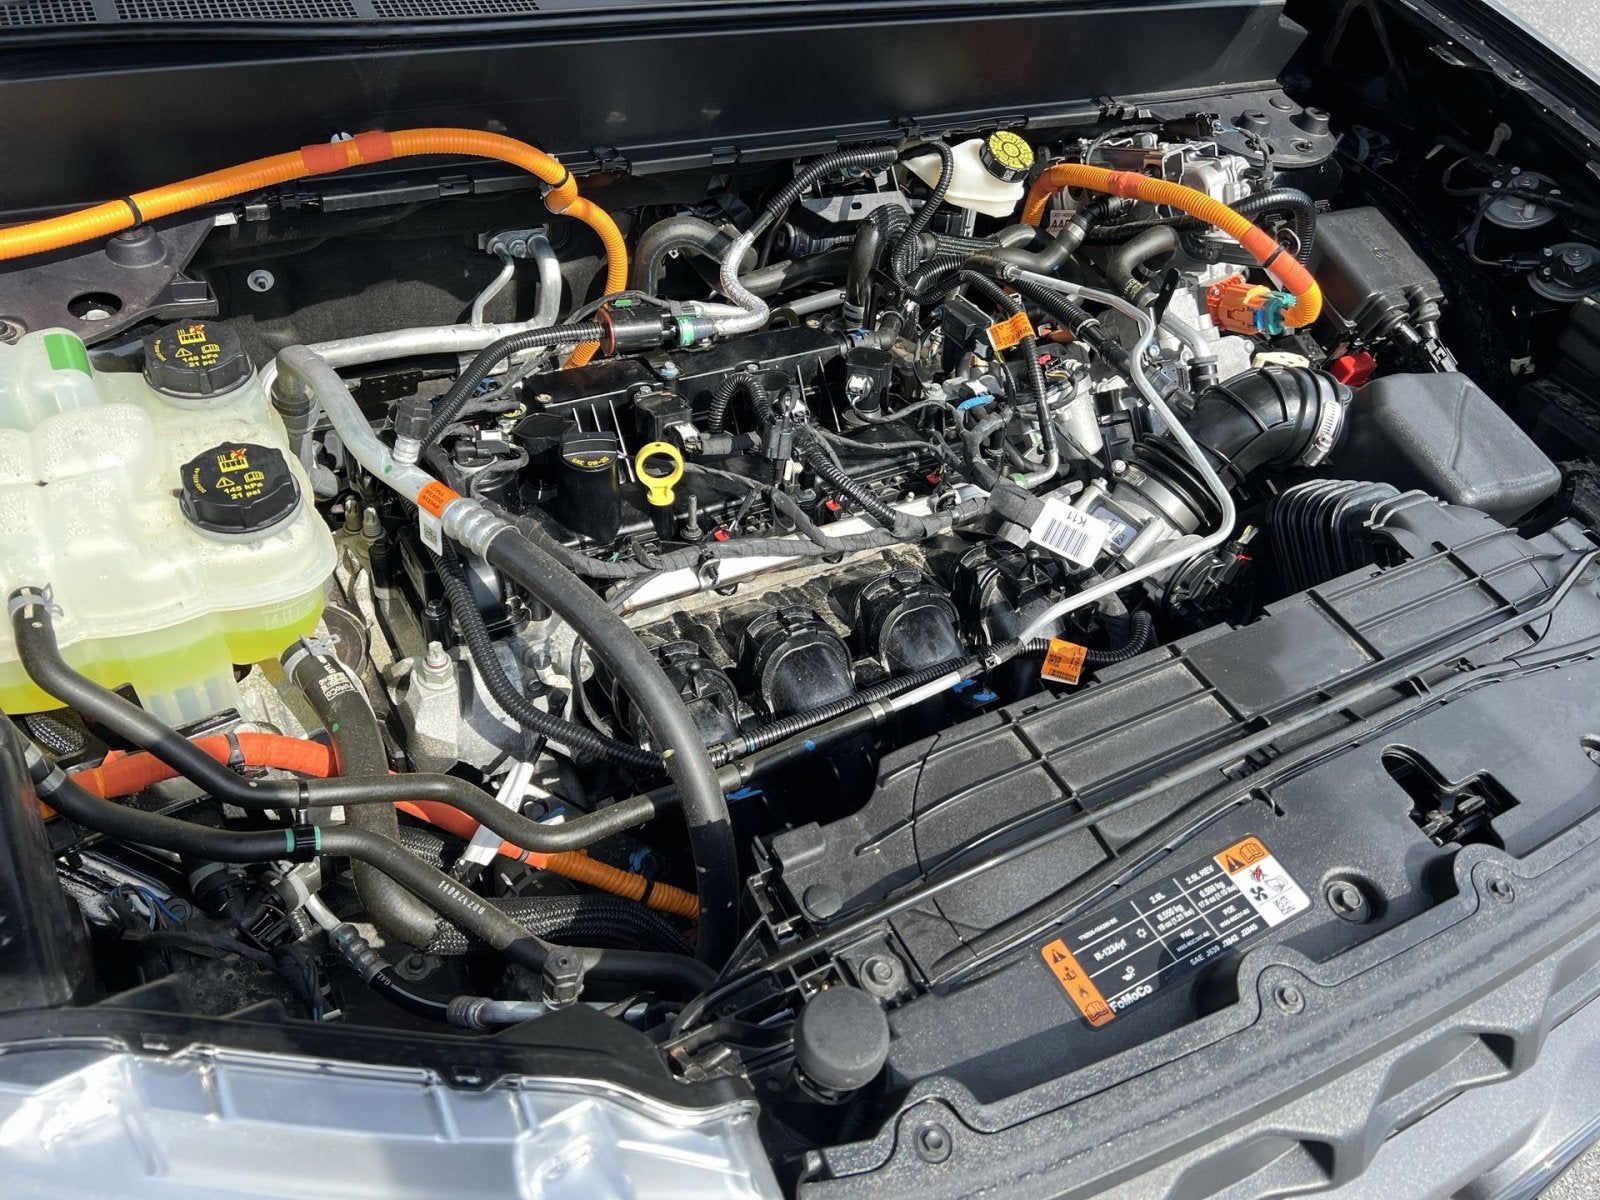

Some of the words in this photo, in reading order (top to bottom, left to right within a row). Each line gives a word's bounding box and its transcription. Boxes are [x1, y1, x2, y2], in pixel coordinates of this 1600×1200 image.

[202, 358, 216, 366] psi
[571, 457, 585, 466] SAE
[223, 485, 242, 494] 145
[244, 482, 263, 490] kPa
[231, 492, 243, 500] 21
[246, 488, 261, 498] psi
[1066, 511, 1088, 527] K11
[1199, 864, 1215, 877] HEV
[1214, 881, 1226, 891] kg
[1172, 904, 1185, 914] kg
[1093, 938, 1128, 961] R-1234yf
[1190, 953, 1205, 966] SAE
[1109, 984, 1153, 1013] FoMoCo
